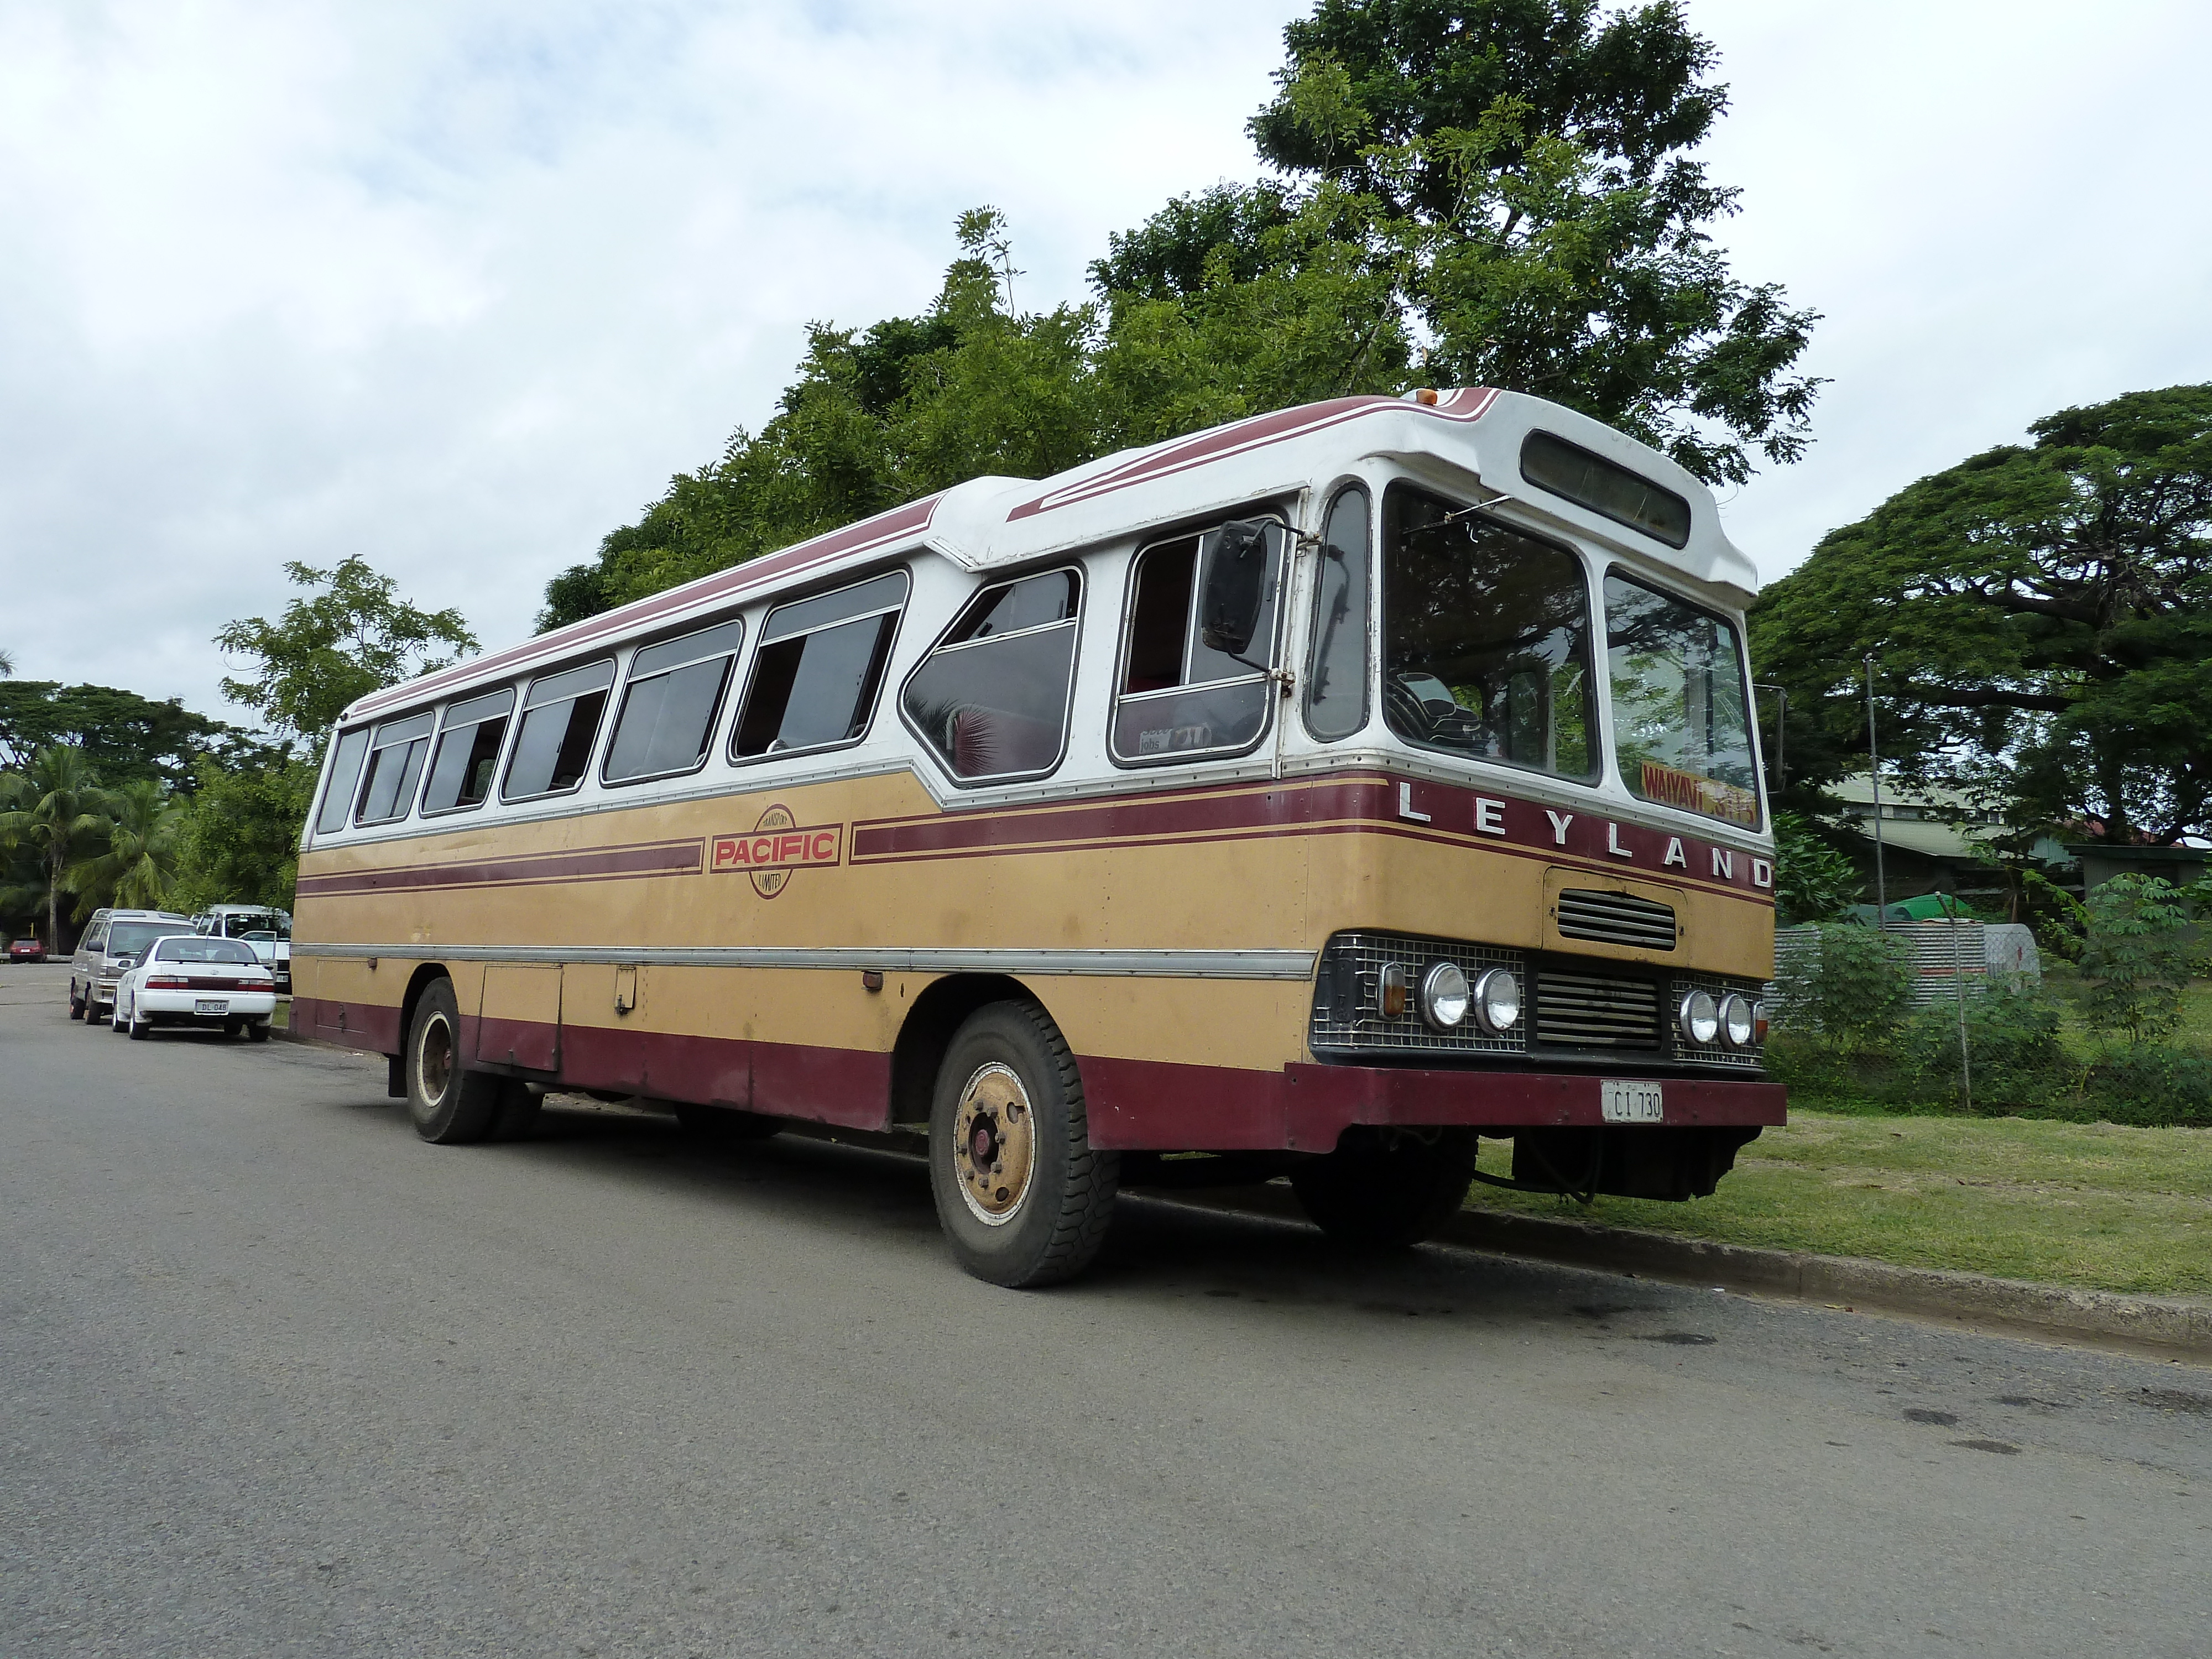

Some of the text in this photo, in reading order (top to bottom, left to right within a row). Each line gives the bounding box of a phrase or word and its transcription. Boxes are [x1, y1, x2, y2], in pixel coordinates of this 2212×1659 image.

[1141, 738, 1160, 753] jobs
[1397, 782, 1771, 887] LEYLAND
[715, 833, 834, 865] PACIFIC
[758, 873, 781, 891] LIMITED
